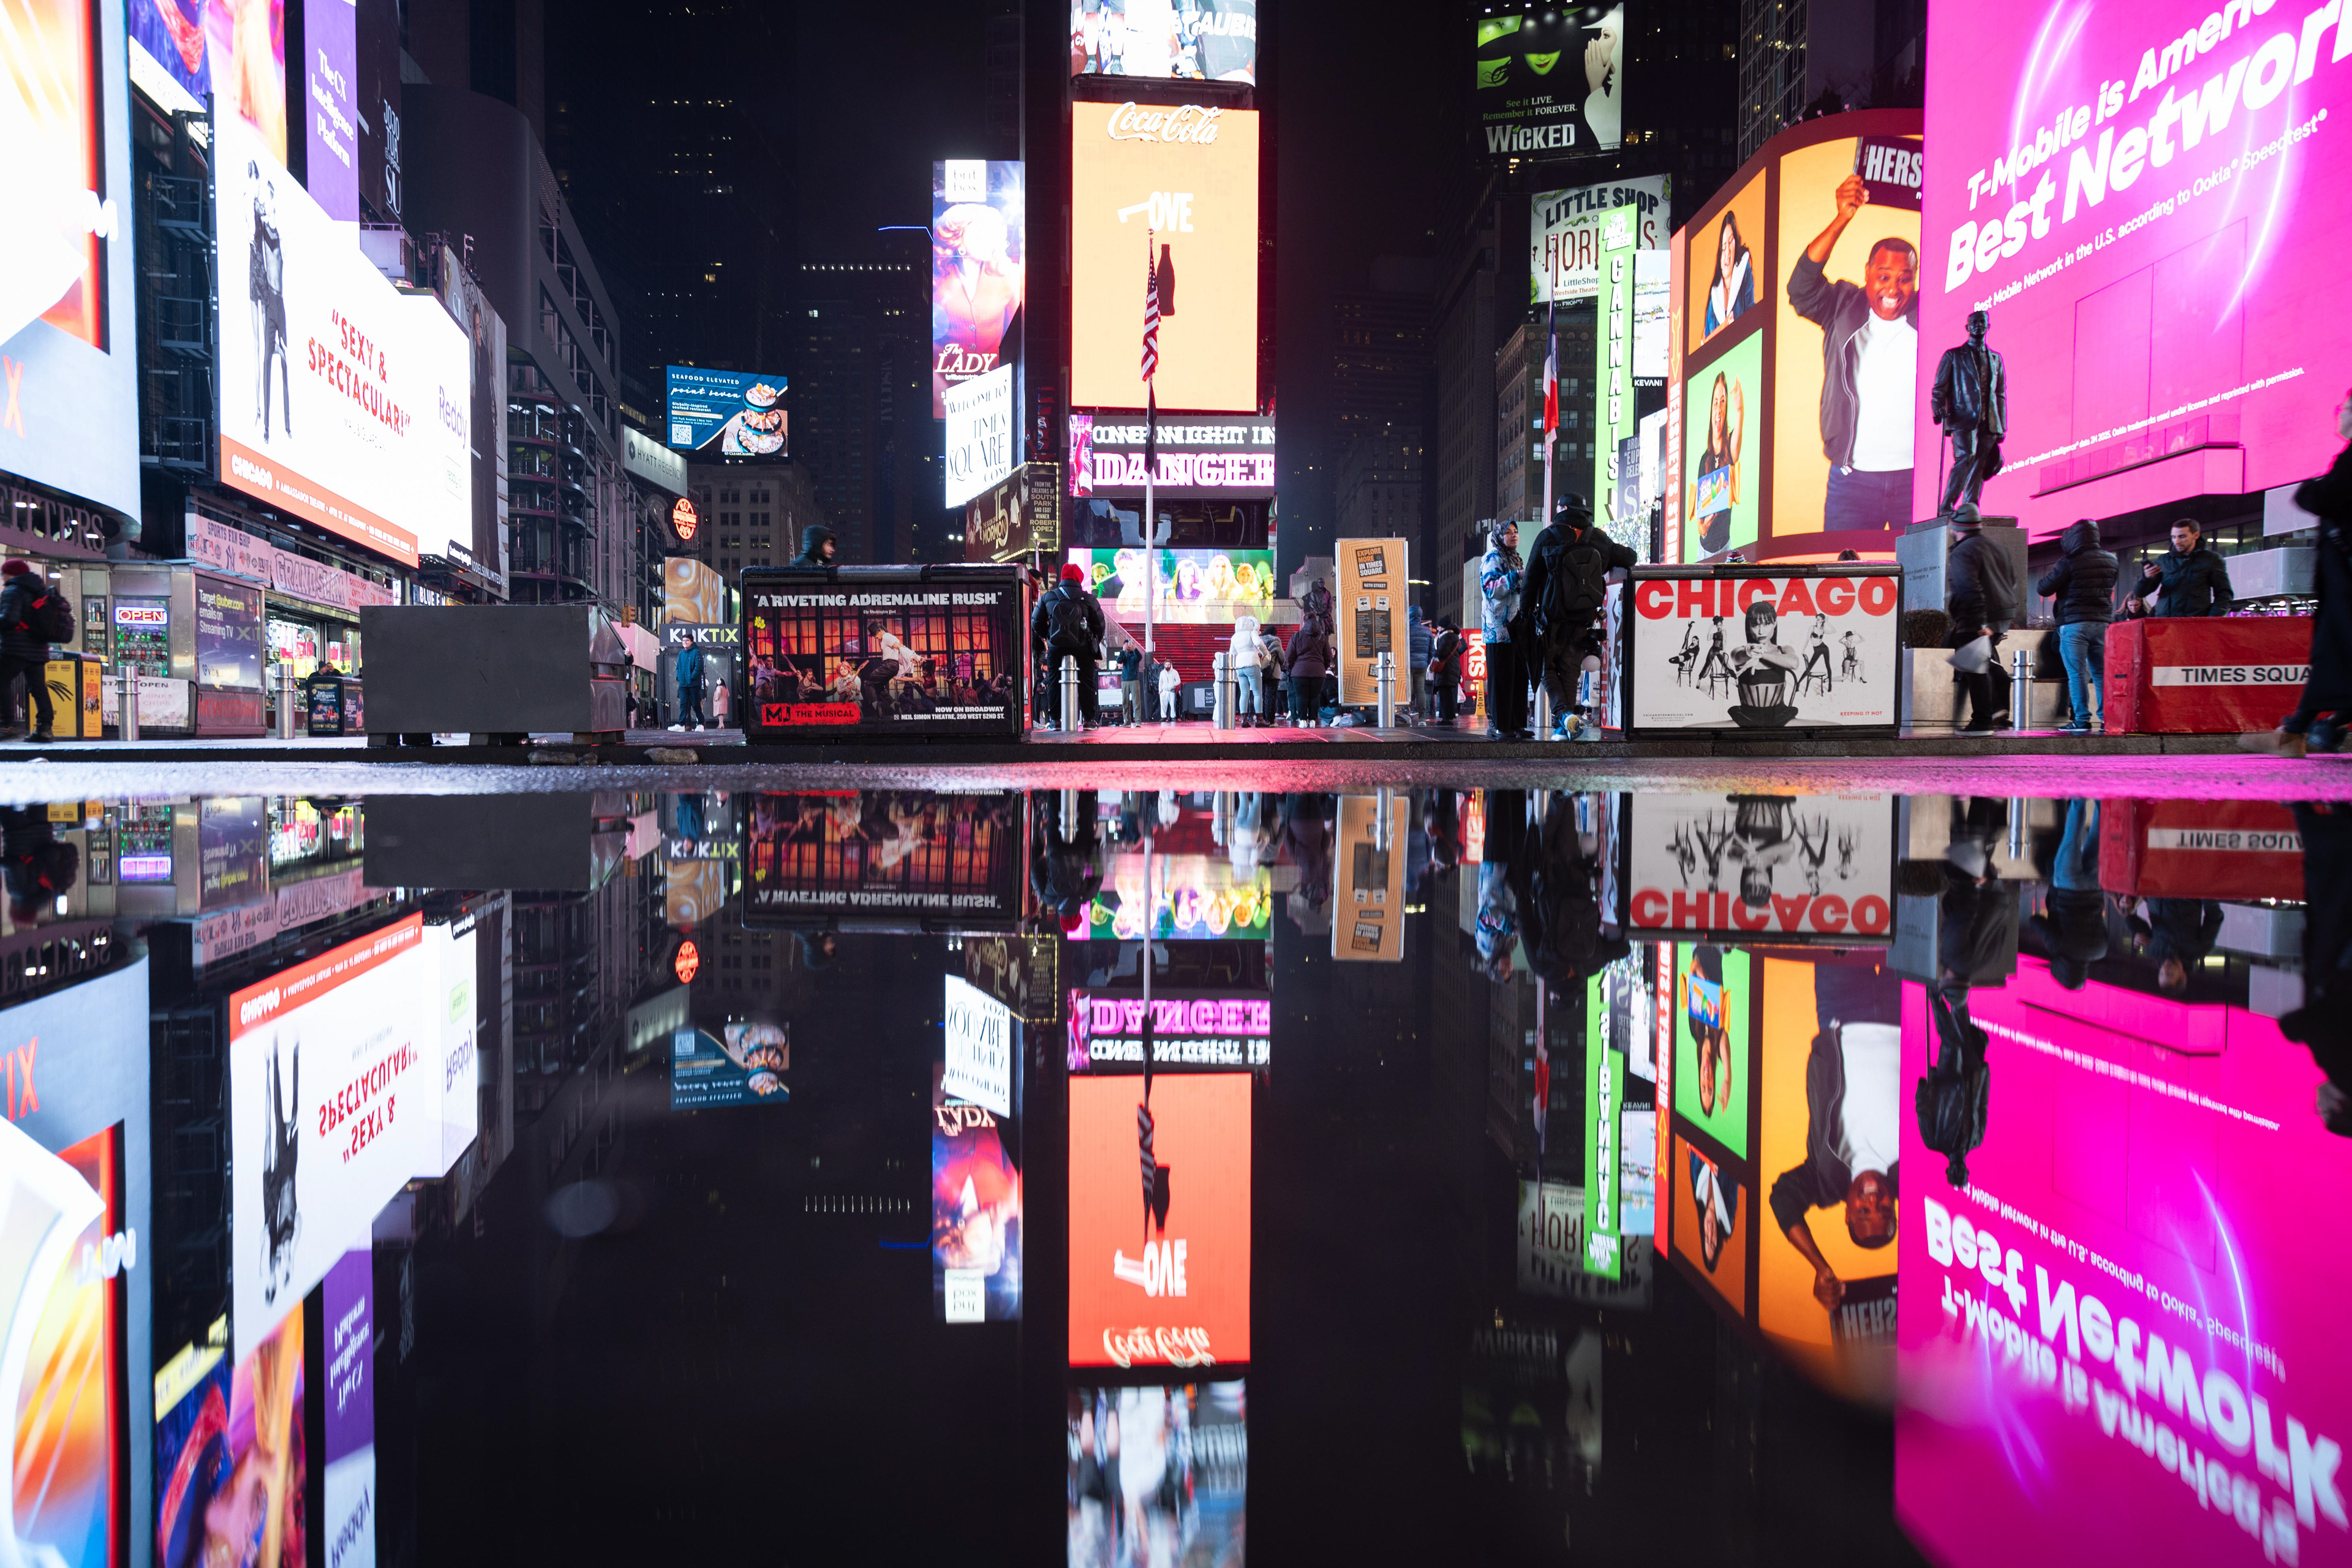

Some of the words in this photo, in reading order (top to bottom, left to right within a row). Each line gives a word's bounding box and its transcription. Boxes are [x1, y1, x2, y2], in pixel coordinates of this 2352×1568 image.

[318, 48, 334, 86] The
[334, 70, 347, 102] CX
[311, 72, 354, 141] Intelligence
[1483, 109, 1525, 121] Remember
[1535, 104, 1578, 116] FOREVER.
[1506, 99, 1521, 108] See
[1523, 98, 1529, 107] it
[1531, 96, 1554, 105] LIVE.
[383, 99, 400, 141] JOJO
[1107, 101, 1225, 145] Coca-Cola
[317, 111, 350, 168] Platform
[1967, 104, 2090, 211] T-Mobile
[2095, 80, 2125, 125] is
[1865, 145, 1923, 189] HERS
[1545, 187, 1607, 230] LITTLE
[1612, 187, 1659, 216] SHOP
[1944, 169, 2057, 293] Best
[1993, 281, 2022, 306] Mobile
[2023, 257, 2063, 289] Network
[2064, 252, 2075, 267] in
[2076, 238, 2093, 261] the
[2095, 228, 2116, 251] U.S.
[2117, 198, 2174, 239] according
[2177, 189, 2190, 206] to
[943, 343, 963, 355] The
[379, 351, 387, 384] &
[935, 353, 998, 374] LADY
[1608, 254, 1624, 480] CANNABIS
[670, 386, 706, 396] point
[709, 390, 741, 398] seven
[706, 377, 739, 385] ELEVATED
[2208, 393, 2220, 405] and
[2221, 383, 2250, 401] reprinted
[2250, 379, 2265, 391] with
[2266, 367, 2304, 388] permission.
[439, 385, 467, 450] Reddy
[974, 410, 1006, 439] TIMES
[1668, 382, 1681, 497] HERSHEY'S
[638, 448, 657, 467] HYATT
[658, 459, 683, 481] REGENCY
[948, 432, 1005, 481] SQUARE
[1093, 453, 1275, 486] DANGER
[231, 454, 273, 491] CHICAGO
[208, 521, 227, 541] SPORTS
[228, 529, 238, 545] FAN
[239, 533, 251, 549] SHOP
[982, 519, 1006, 545] MORMON
[1357, 547, 1382, 557] EXPLORE
[1357, 555, 1374, 564] MORE
[1366, 560, 1383, 569] TIMES
[1360, 567, 1383, 578] SQUARE
[198, 589, 216, 607] Target
[216, 593, 245, 612] @uber.com
[419, 586, 435, 606] BLUE
[771, 594, 846, 607] RIVETING
[849, 594, 949, 606] ADRENALINE
[1635, 576, 1898, 620] CHICAGO
[119, 610, 164, 622] OPEN
[199, 606, 216, 620] emails
[216, 611, 224, 622] on
[200, 620, 226, 640] Streaming
[225, 624, 234, 638] TV
[2180, 667, 2247, 684] TIMES
[198, 698, 260, 718] NEWSSTAND
[764, 706, 791, 723] MJ
[815, 709, 854, 718] MUSICAL
